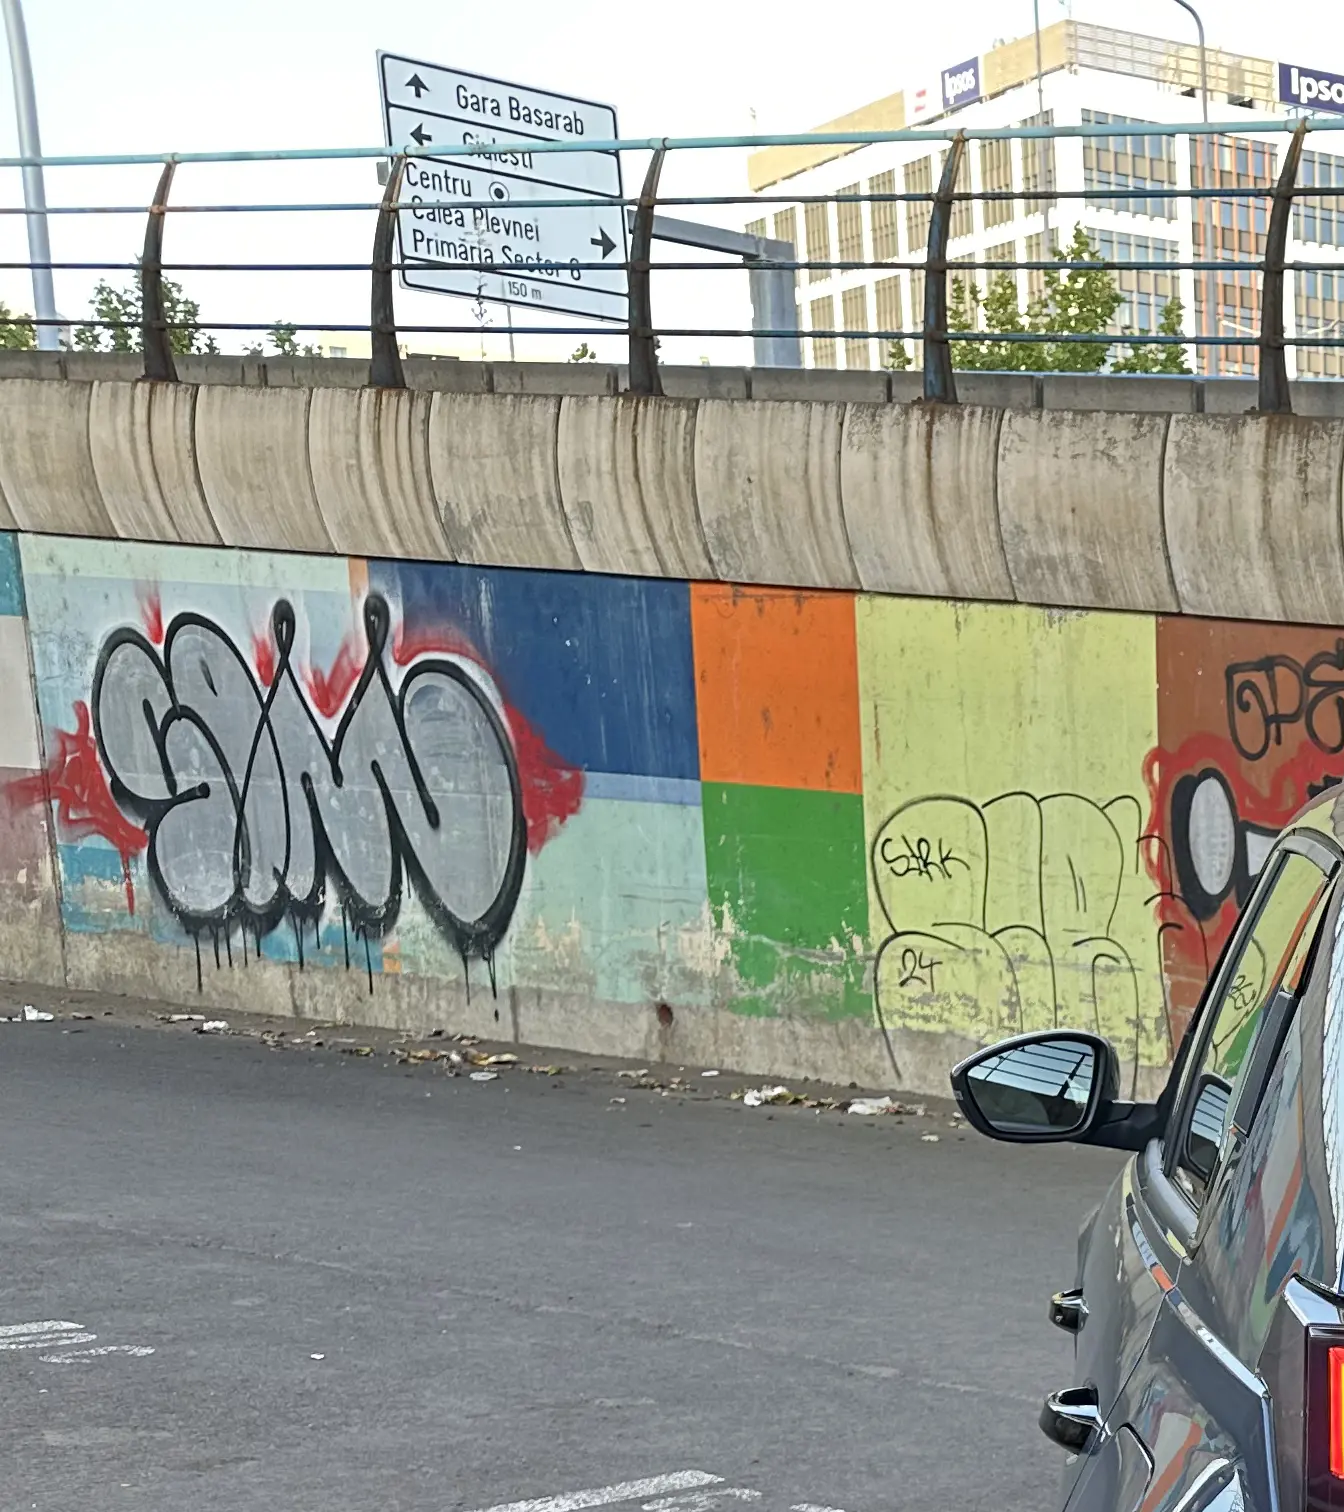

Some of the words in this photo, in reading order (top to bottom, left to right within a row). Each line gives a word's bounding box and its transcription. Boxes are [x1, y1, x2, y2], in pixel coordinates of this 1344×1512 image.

[944, 67, 976, 104] Ipsos
[456, 84, 501, 118] Gara
[509, 96, 585, 136] Basarab
[406, 162, 472, 198] Centru
[411, 195, 465, 228] Calea
[473, 207, 541, 243] Plevnei
[412, 228, 494, 265] Primăria
[501, 244, 562, 279] Sector
[508, 281, 527, 299] 150
[531, 286, 542, 300] m
